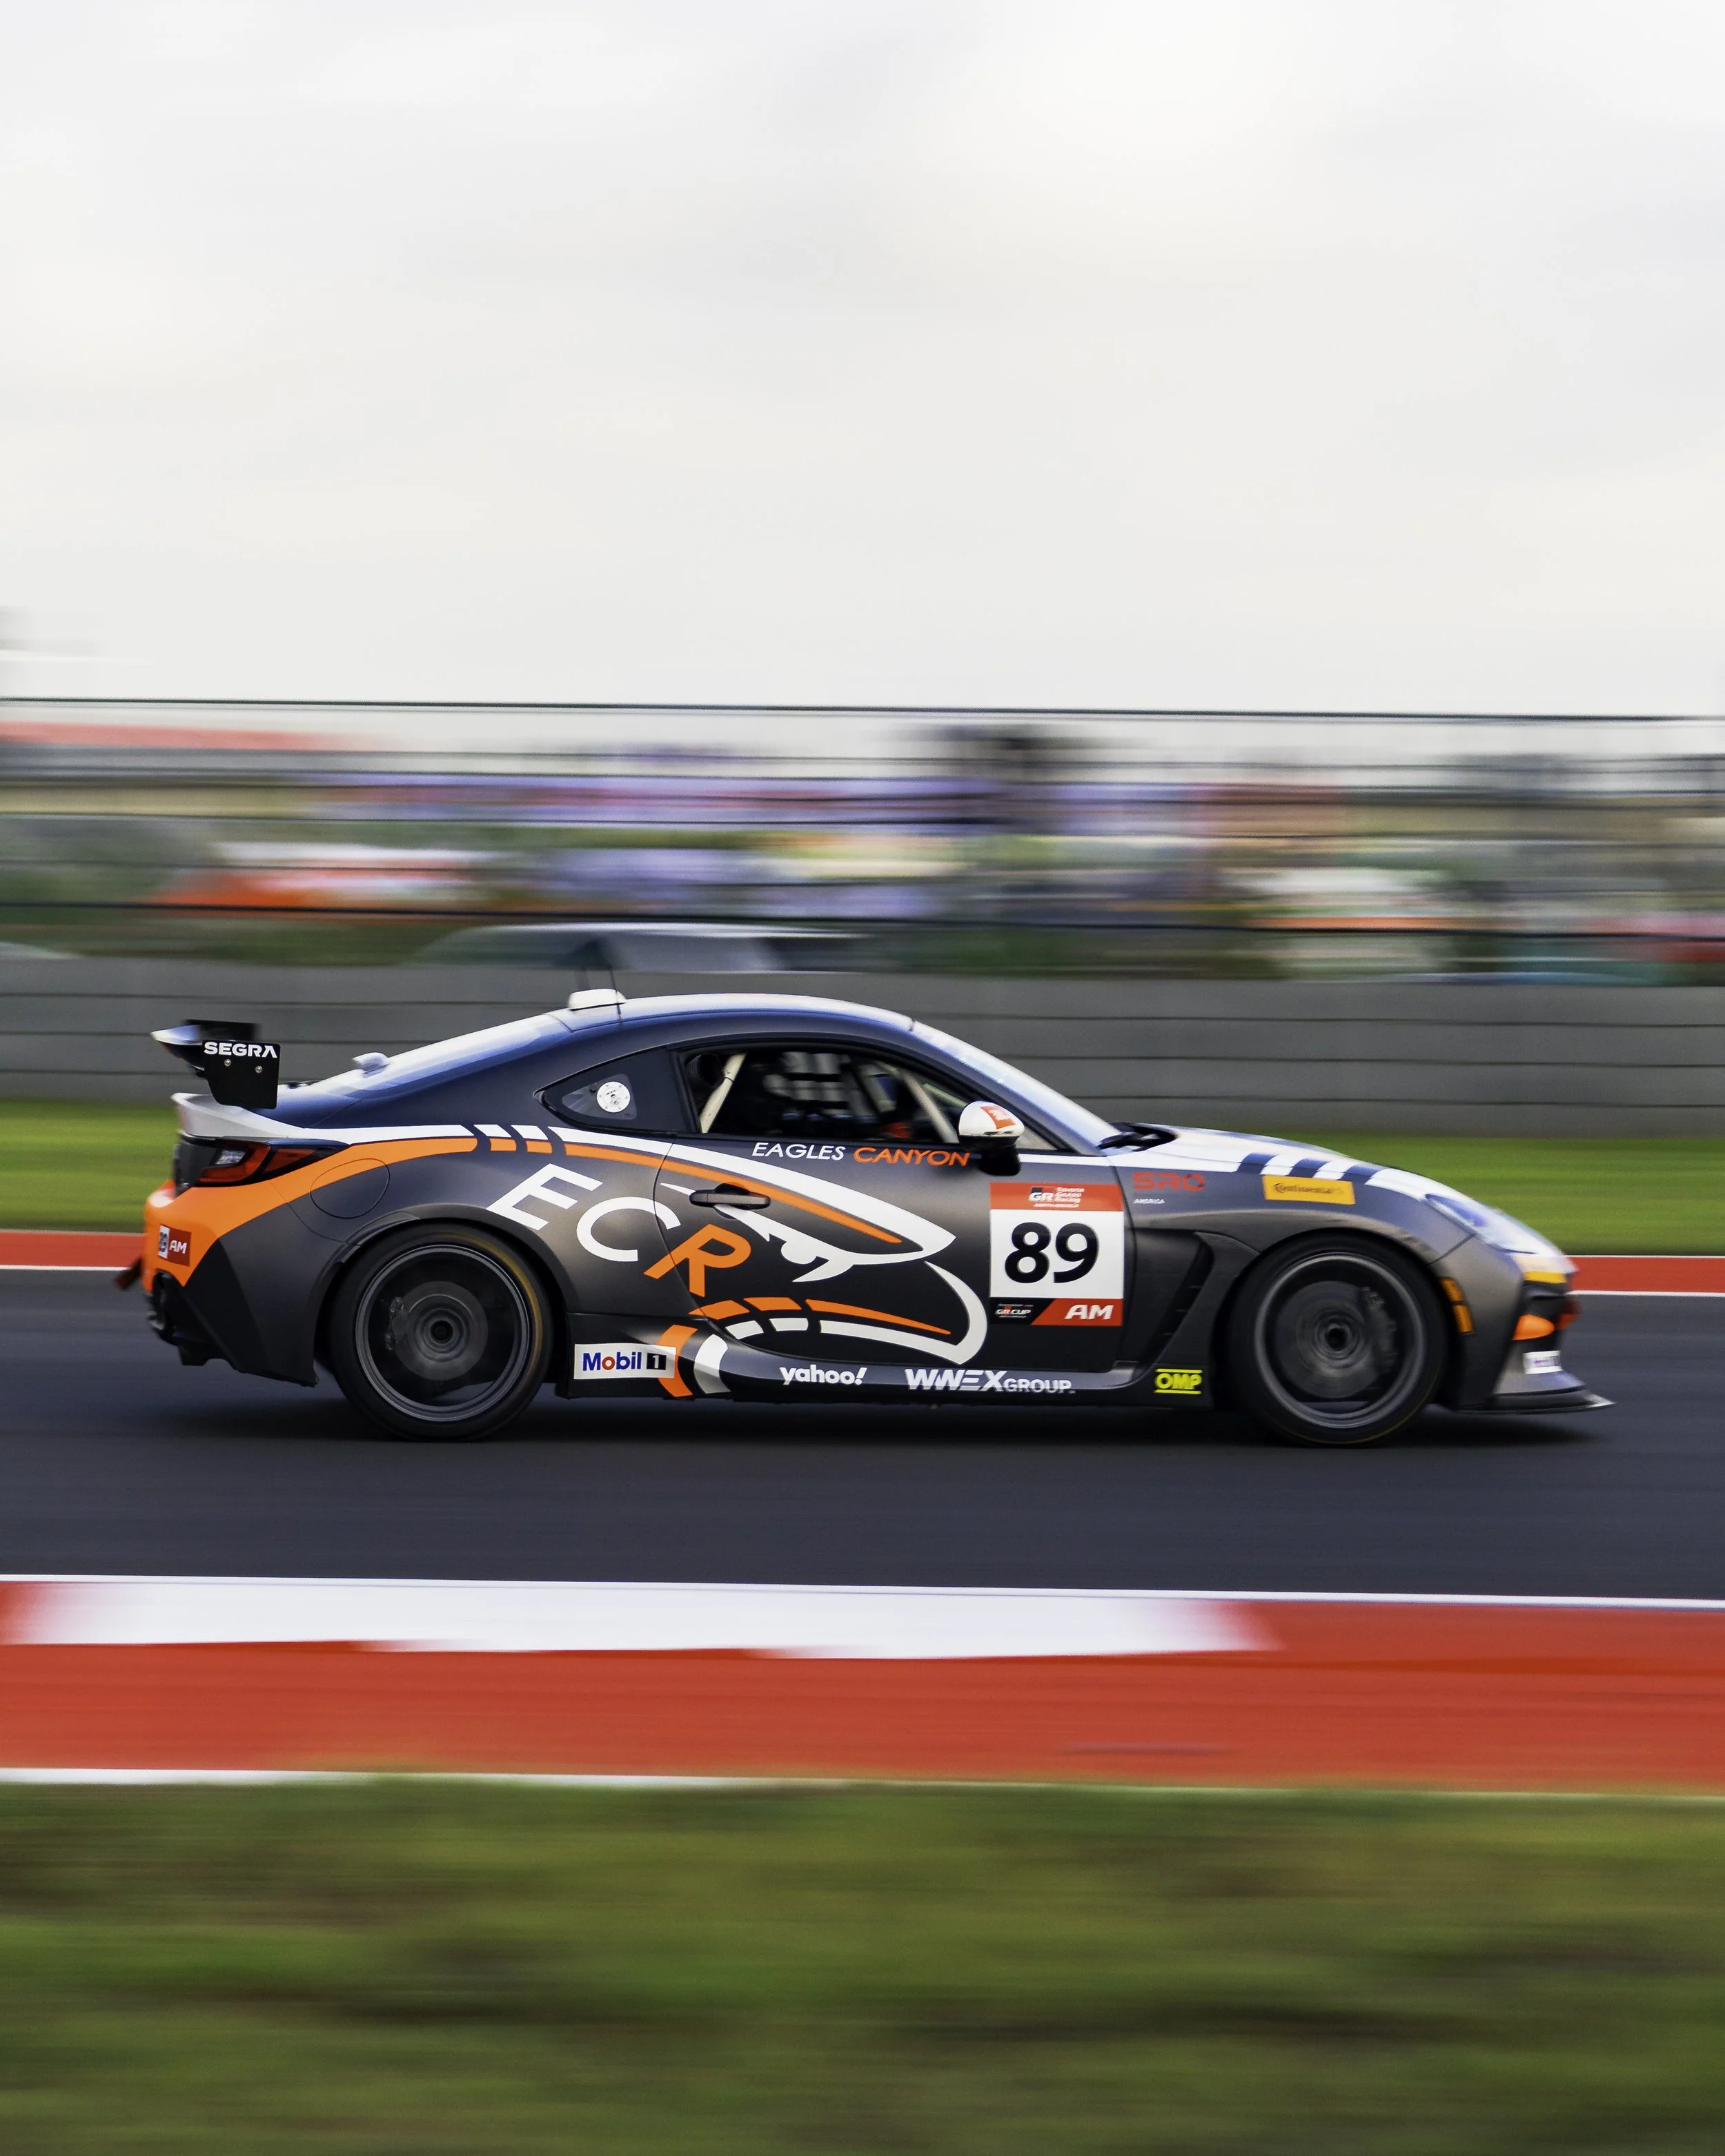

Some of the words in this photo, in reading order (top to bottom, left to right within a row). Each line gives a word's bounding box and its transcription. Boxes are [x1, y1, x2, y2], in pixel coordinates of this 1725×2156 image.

[204, 1042, 277, 1058] SEGRA
[751, 1143, 846, 1160] EAGLES
[853, 1147, 970, 1167] CANYON
[1132, 1171, 1205, 1192] SRO
[1029, 1192, 1054, 1202] GR
[486, 1163, 751, 1297] ECR
[169, 1240, 187, 1254] AM
[1005, 1222, 1099, 1283] 89
[1064, 1305, 1114, 1320] AM
[582, 1352, 642, 1371] Mobil
[779, 1364, 867, 1385] yahoo!
[1156, 1373, 1202, 1389] OMP
